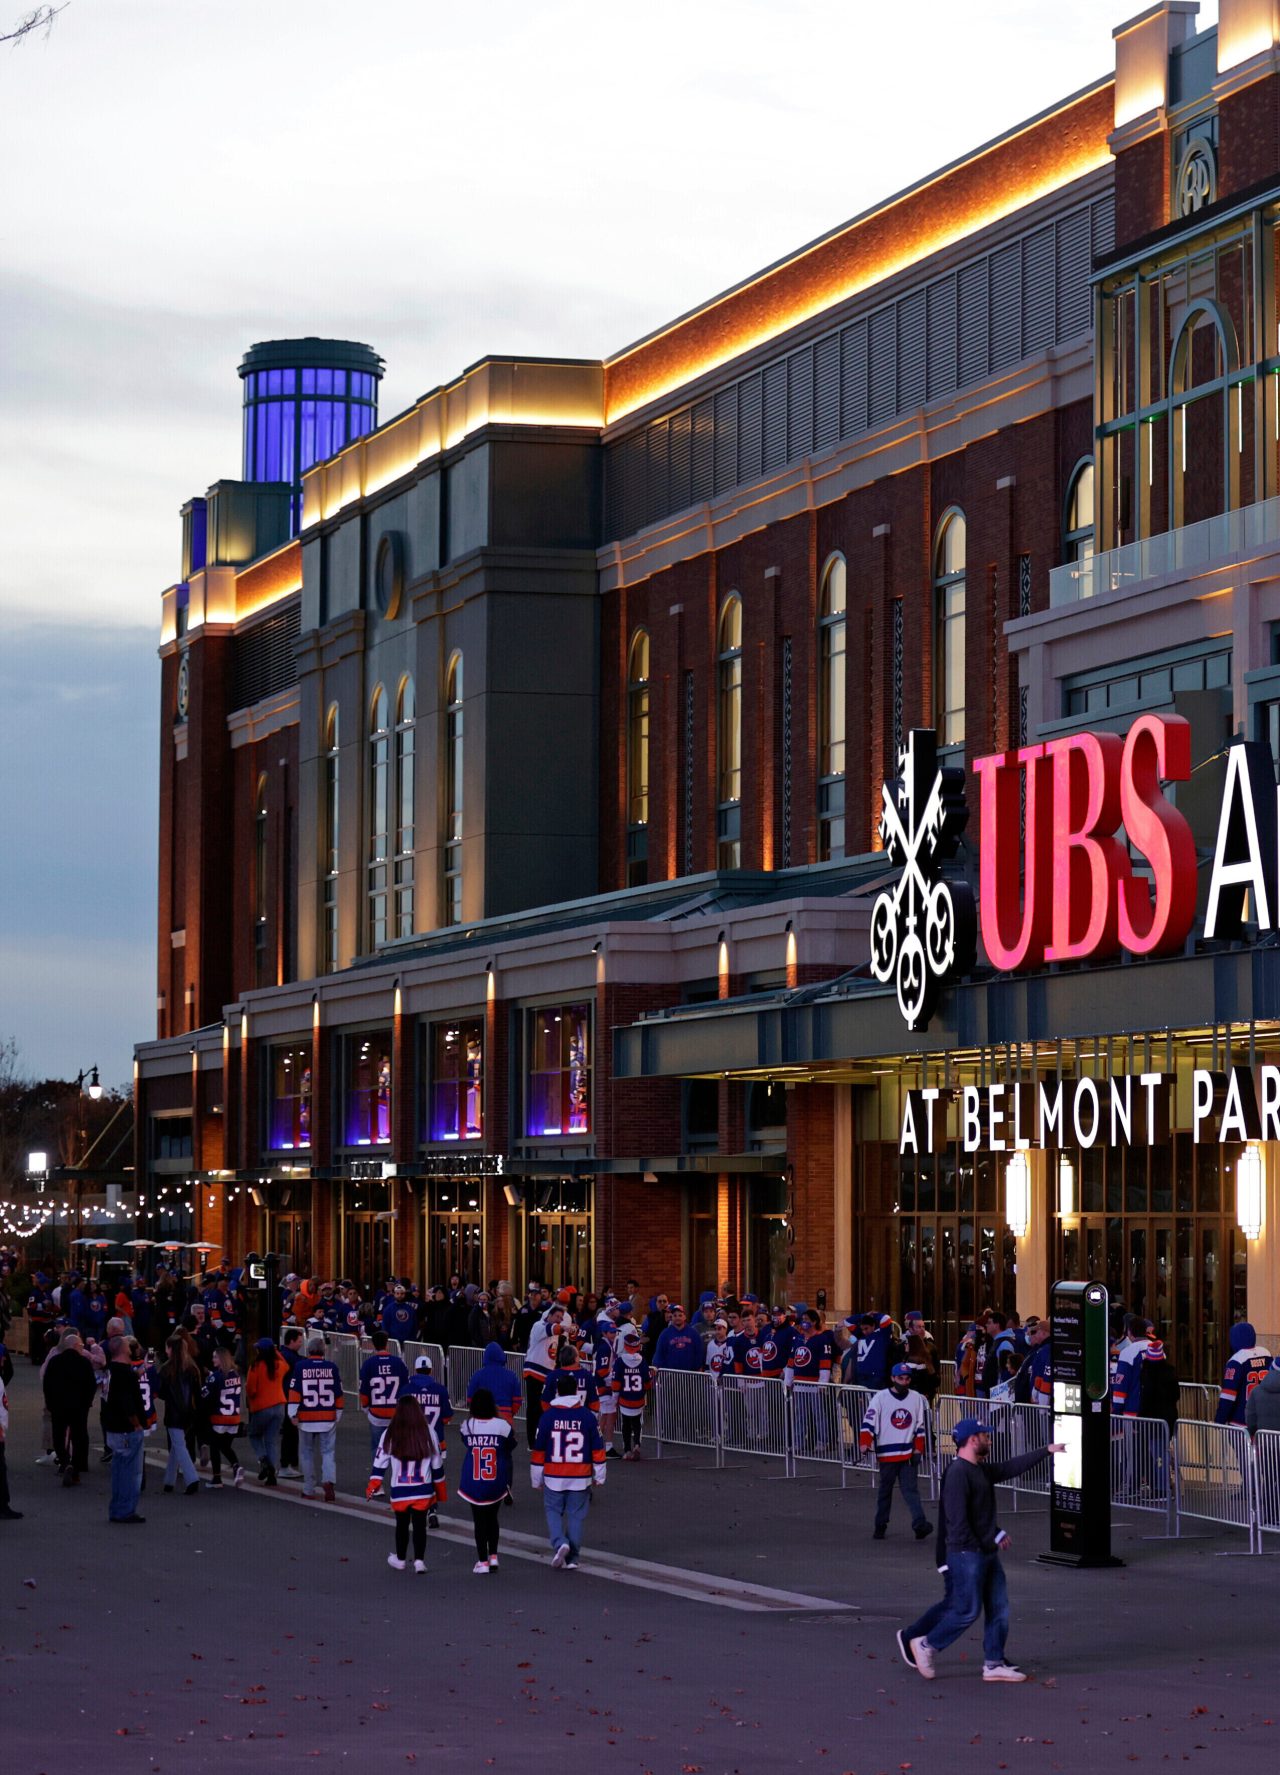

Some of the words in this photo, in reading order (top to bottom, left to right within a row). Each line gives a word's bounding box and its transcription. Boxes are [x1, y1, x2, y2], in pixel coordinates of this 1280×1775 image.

[972, 713, 1192, 971] UBS
[900, 1088, 939, 1154] AT
[963, 1073, 1162, 1152] BELMONT
[857, 1339, 875, 1362] NY
[302, 1369, 333, 1378] BOYCHUK
[378, 1365, 392, 1375] LEE
[301, 1379, 335, 1408] 55
[369, 1376, 400, 1405] 27
[623, 1375, 643, 1392] 13
[553, 1420, 582, 1431] BAILEY
[467, 1435, 500, 1447] BARZAL
[551, 1431, 585, 1463] 12
[472, 1447, 498, 1481] 13
